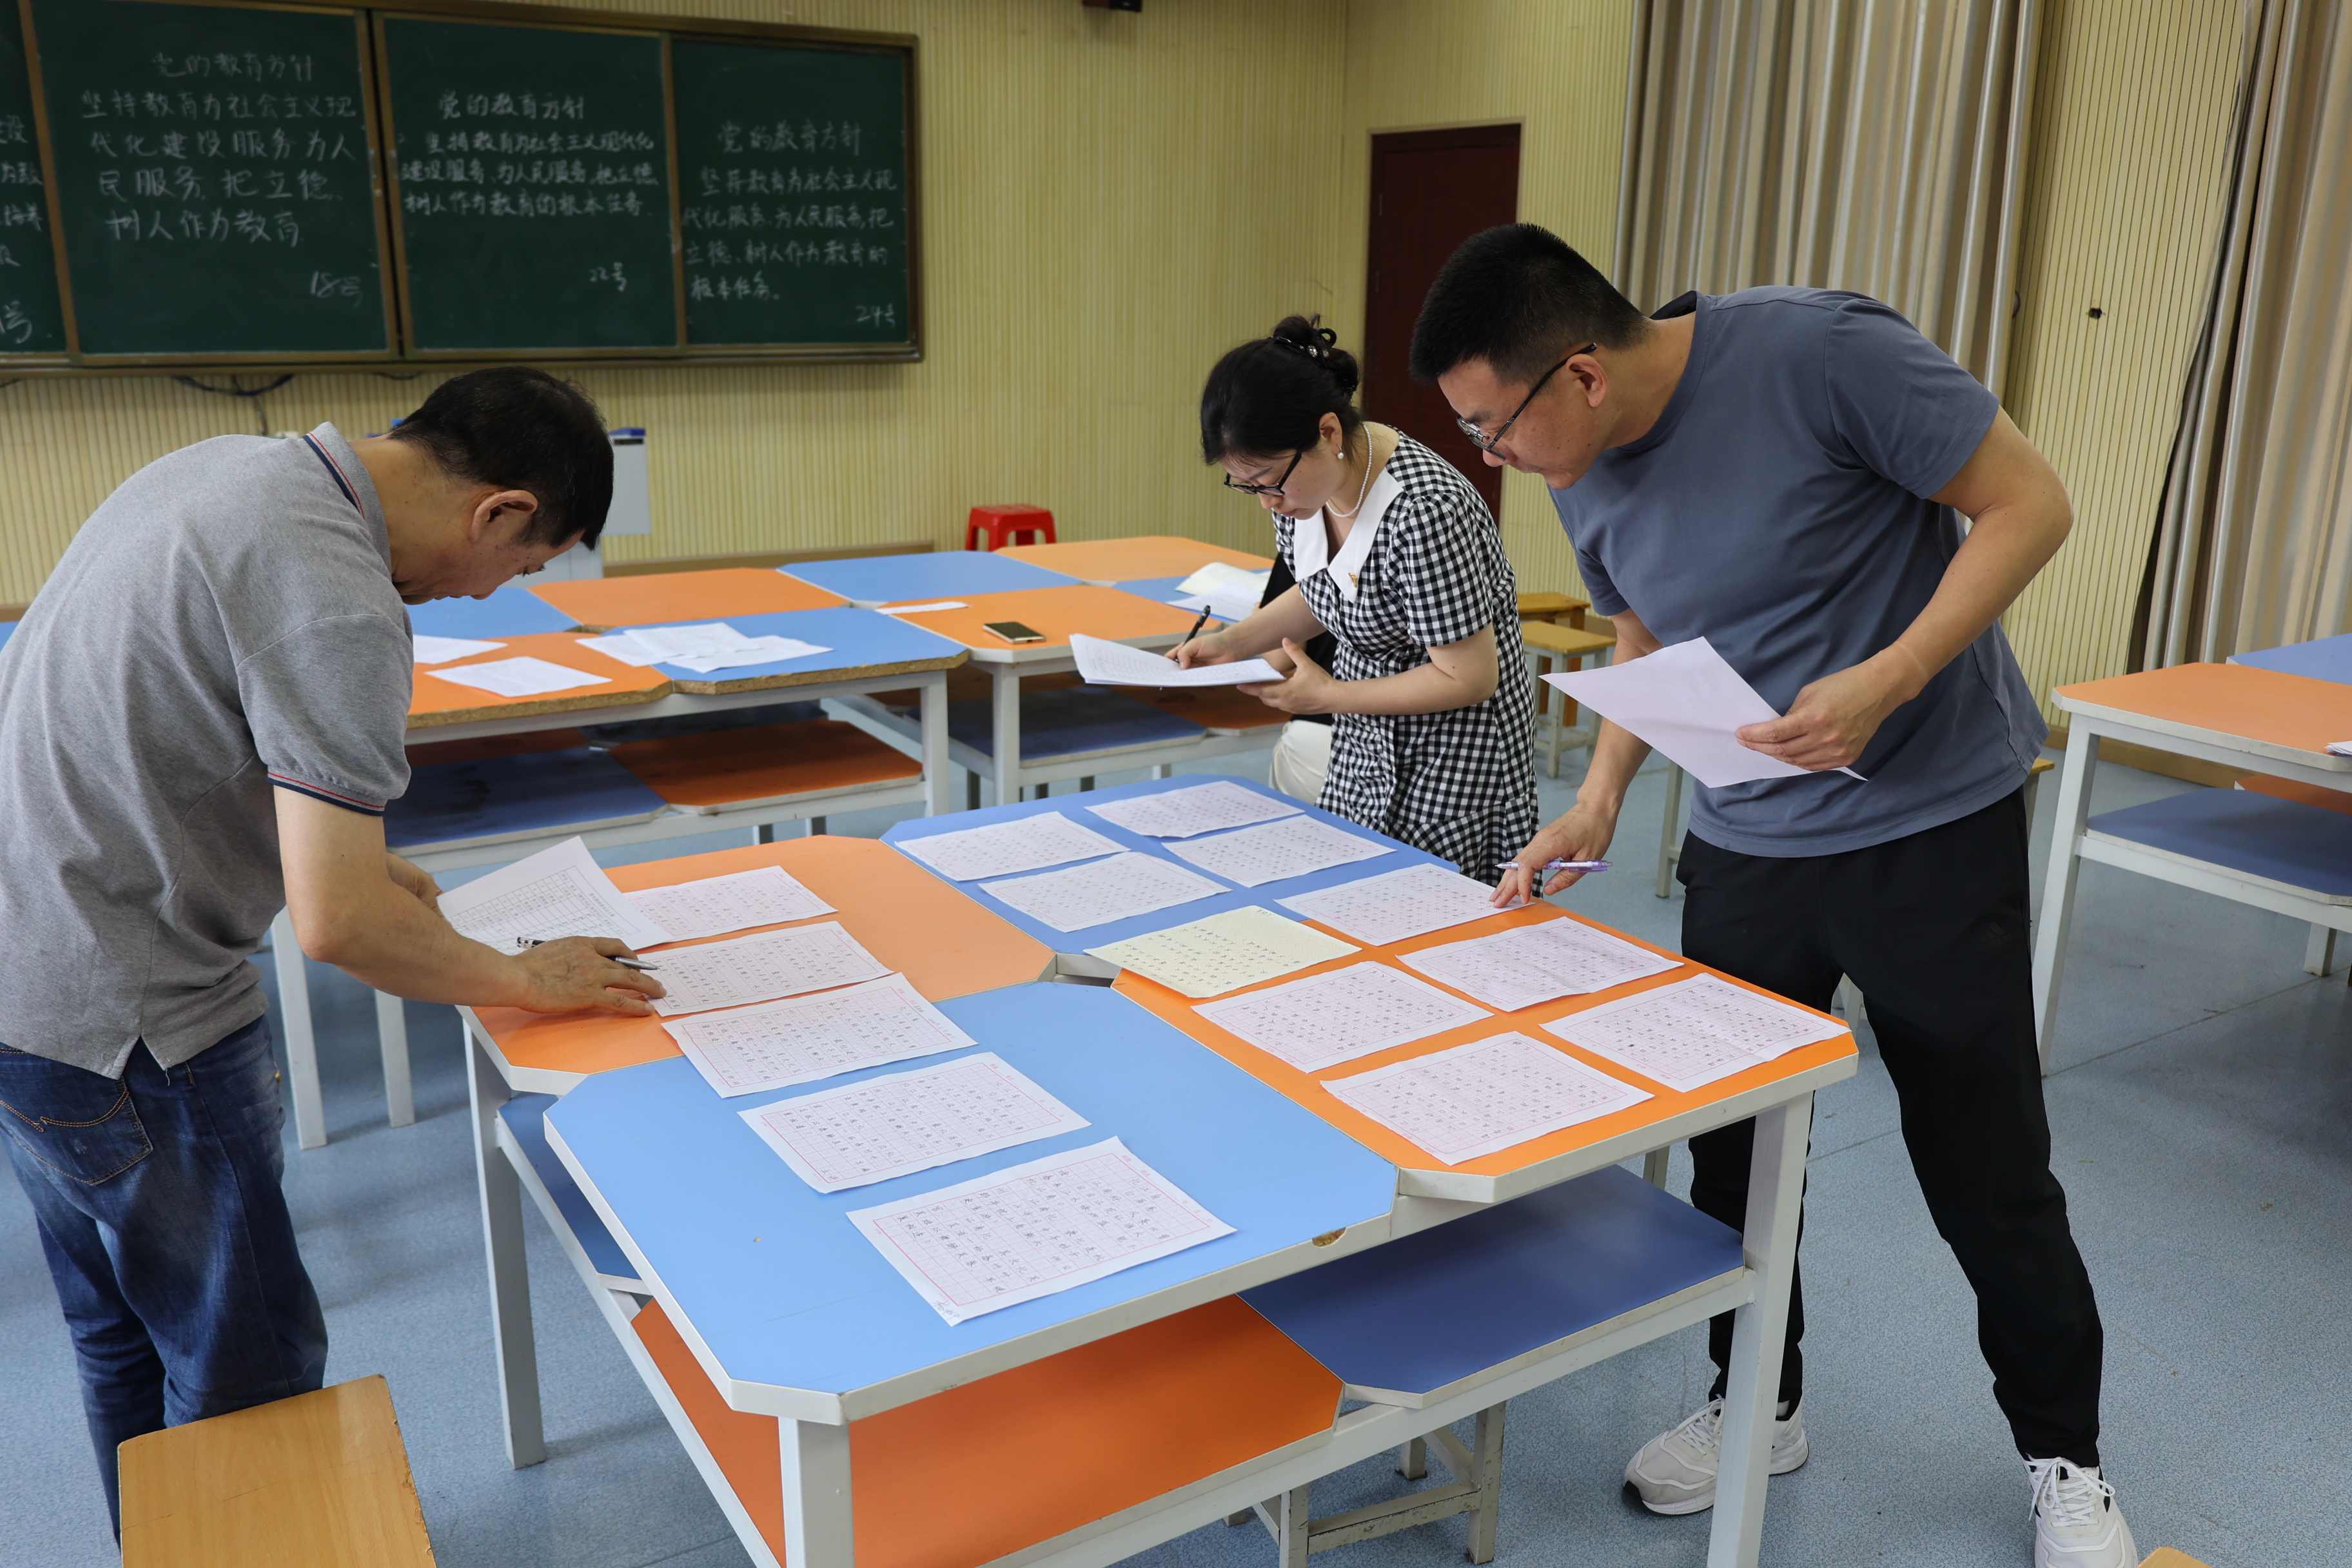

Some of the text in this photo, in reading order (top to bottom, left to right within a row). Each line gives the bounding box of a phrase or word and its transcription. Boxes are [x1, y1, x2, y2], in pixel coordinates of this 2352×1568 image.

[81, 90, 357, 121] 坚持教育为社会主义现
[438, 90, 584, 120] 党的教育方针
[718, 119, 861, 156] 党的教育方针
[310, 271, 363, 307] 18号
[589, 262, 627, 292] 22号
[855, 303, 896, 328] 24号
